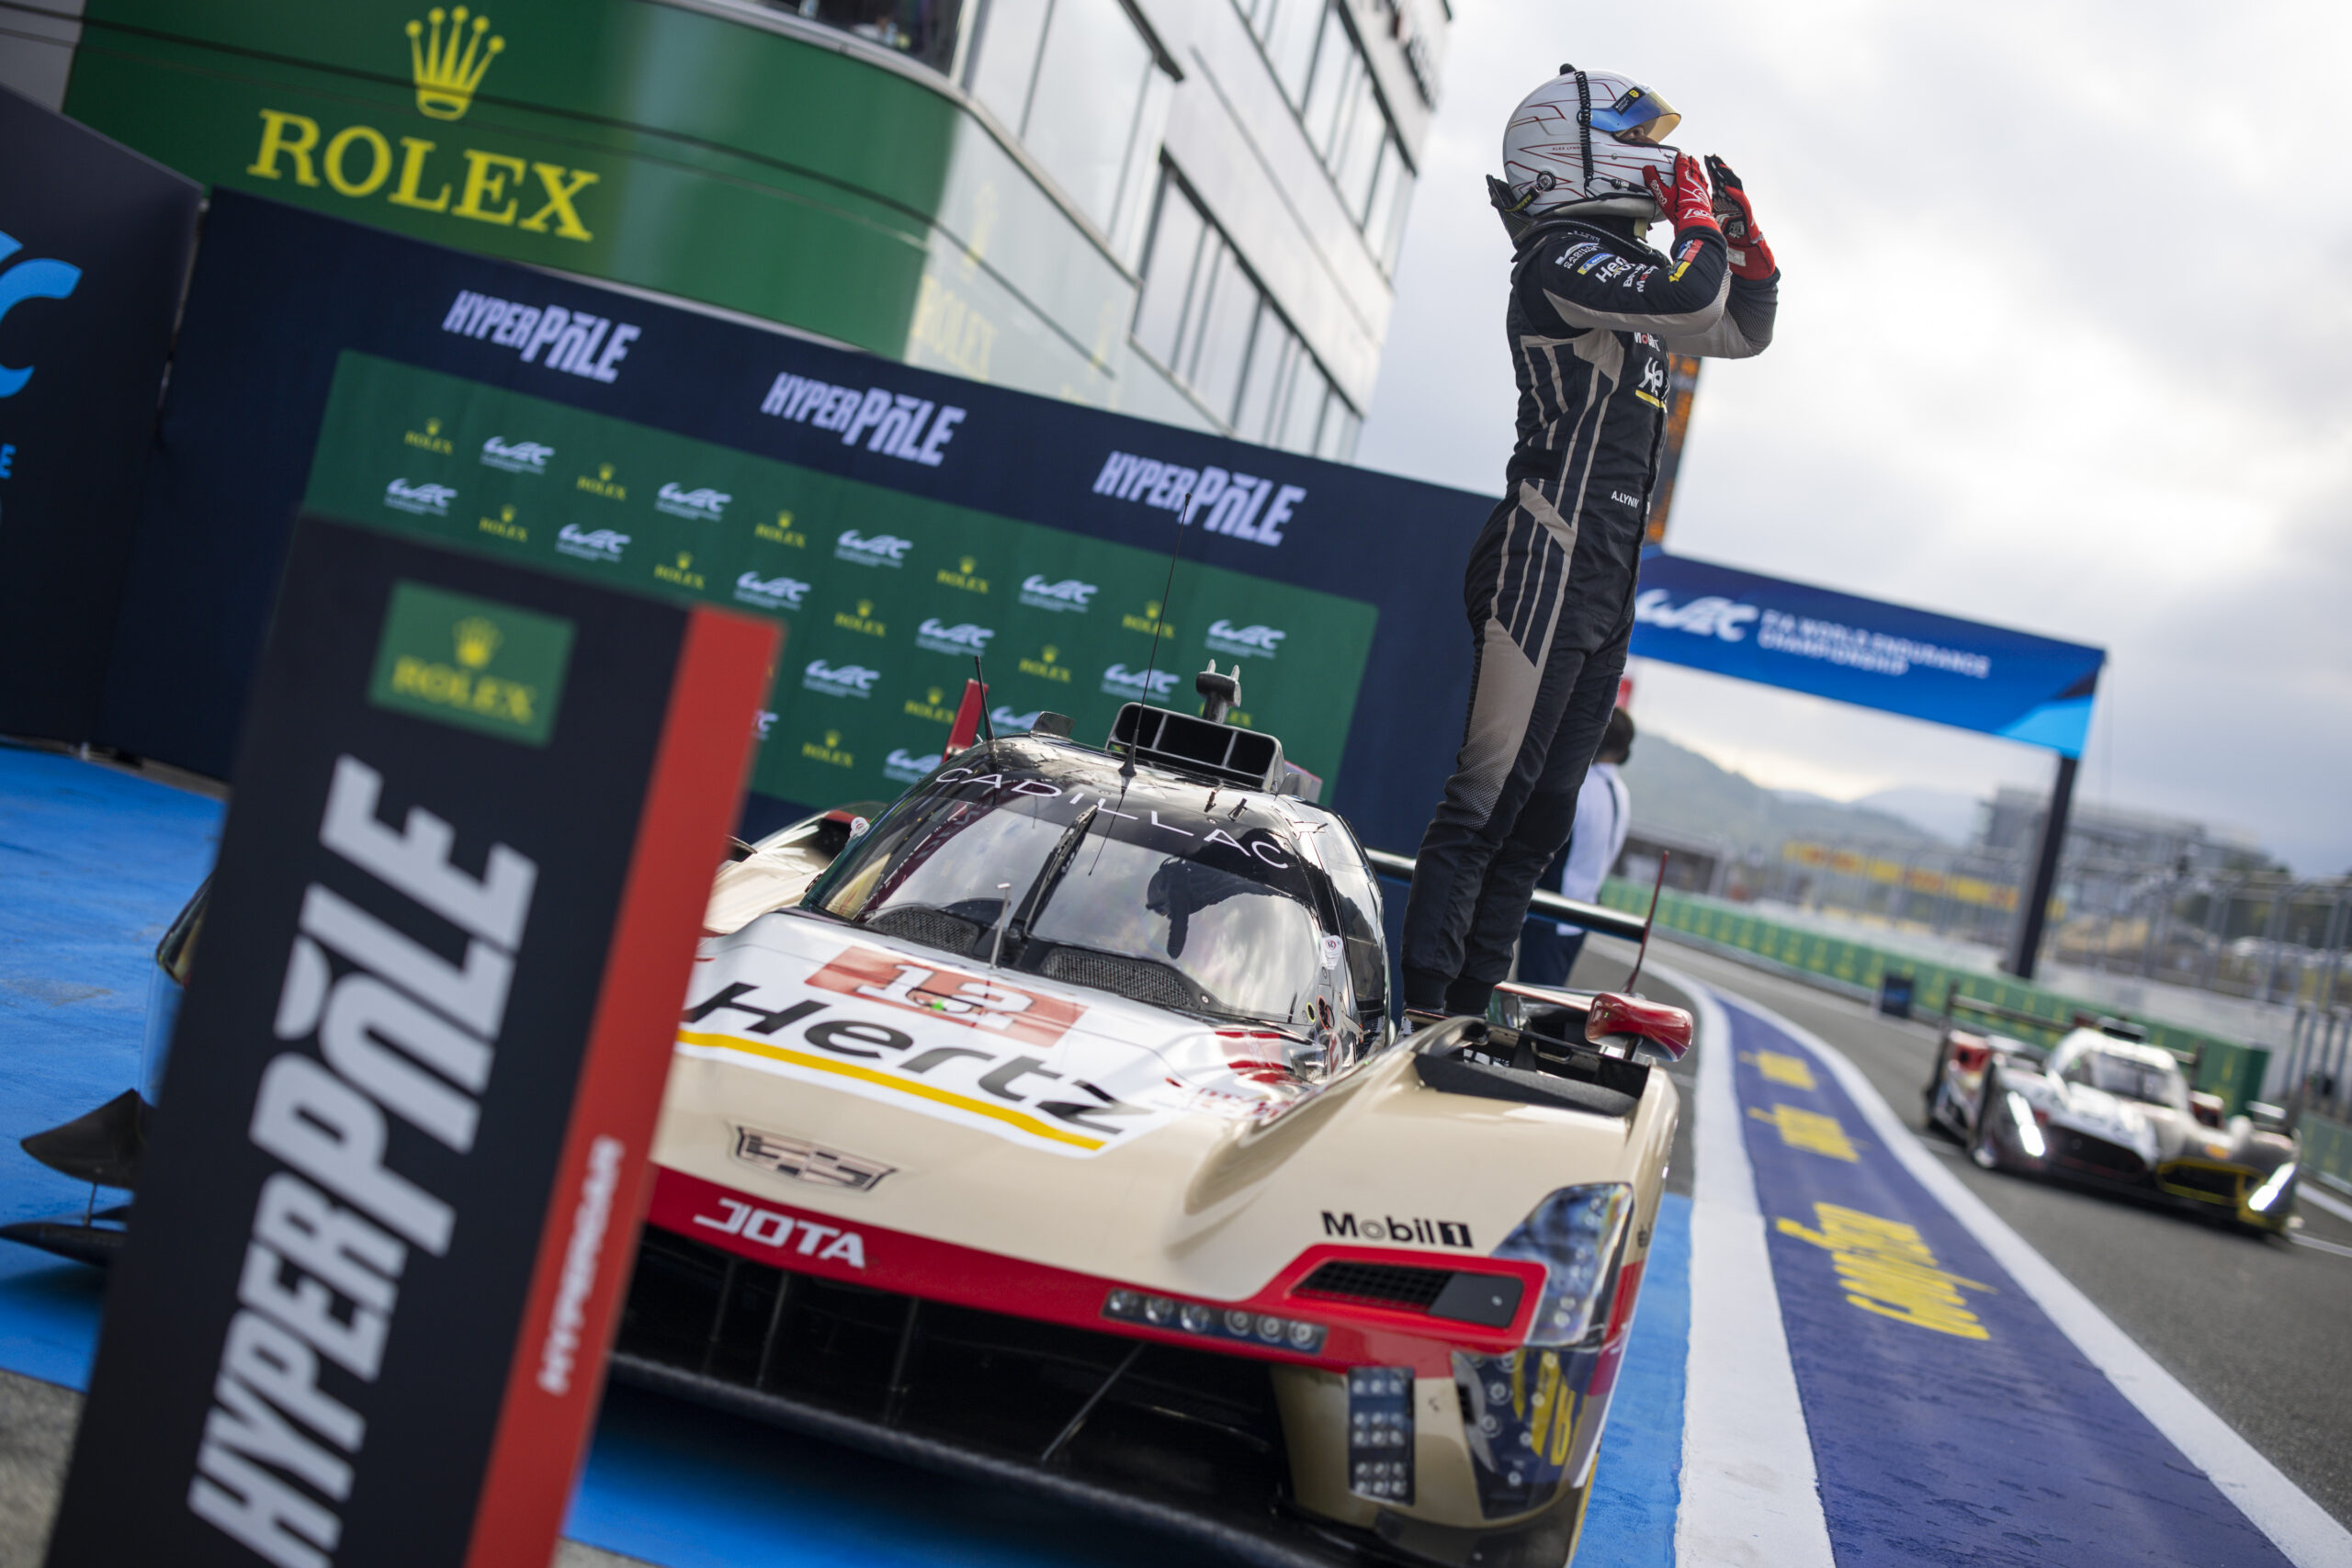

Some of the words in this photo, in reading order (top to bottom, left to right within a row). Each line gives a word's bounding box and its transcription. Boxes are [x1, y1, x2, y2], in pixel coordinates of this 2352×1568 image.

[247, 108, 599, 242] ROLEX
[404, 430, 454, 456] ROLEX
[577, 475, 627, 501] ROLEX
[479, 516, 528, 542] ROLEX
[754, 523, 806, 548] ROLEX
[654, 563, 705, 590] ROLEX
[936, 569, 989, 595] ROLEX
[834, 612, 886, 637] ROLEX
[1122, 615, 1175, 640] ROLEX
[1019, 658, 1070, 683] ROLEX
[391, 655, 537, 726] ROLEX
[802, 742, 854, 768] ROLEX
[935, 768, 1288, 869] CADILLAC
[684, 982, 1156, 1135] Hertz
[693, 1196, 865, 1269] JOTA
